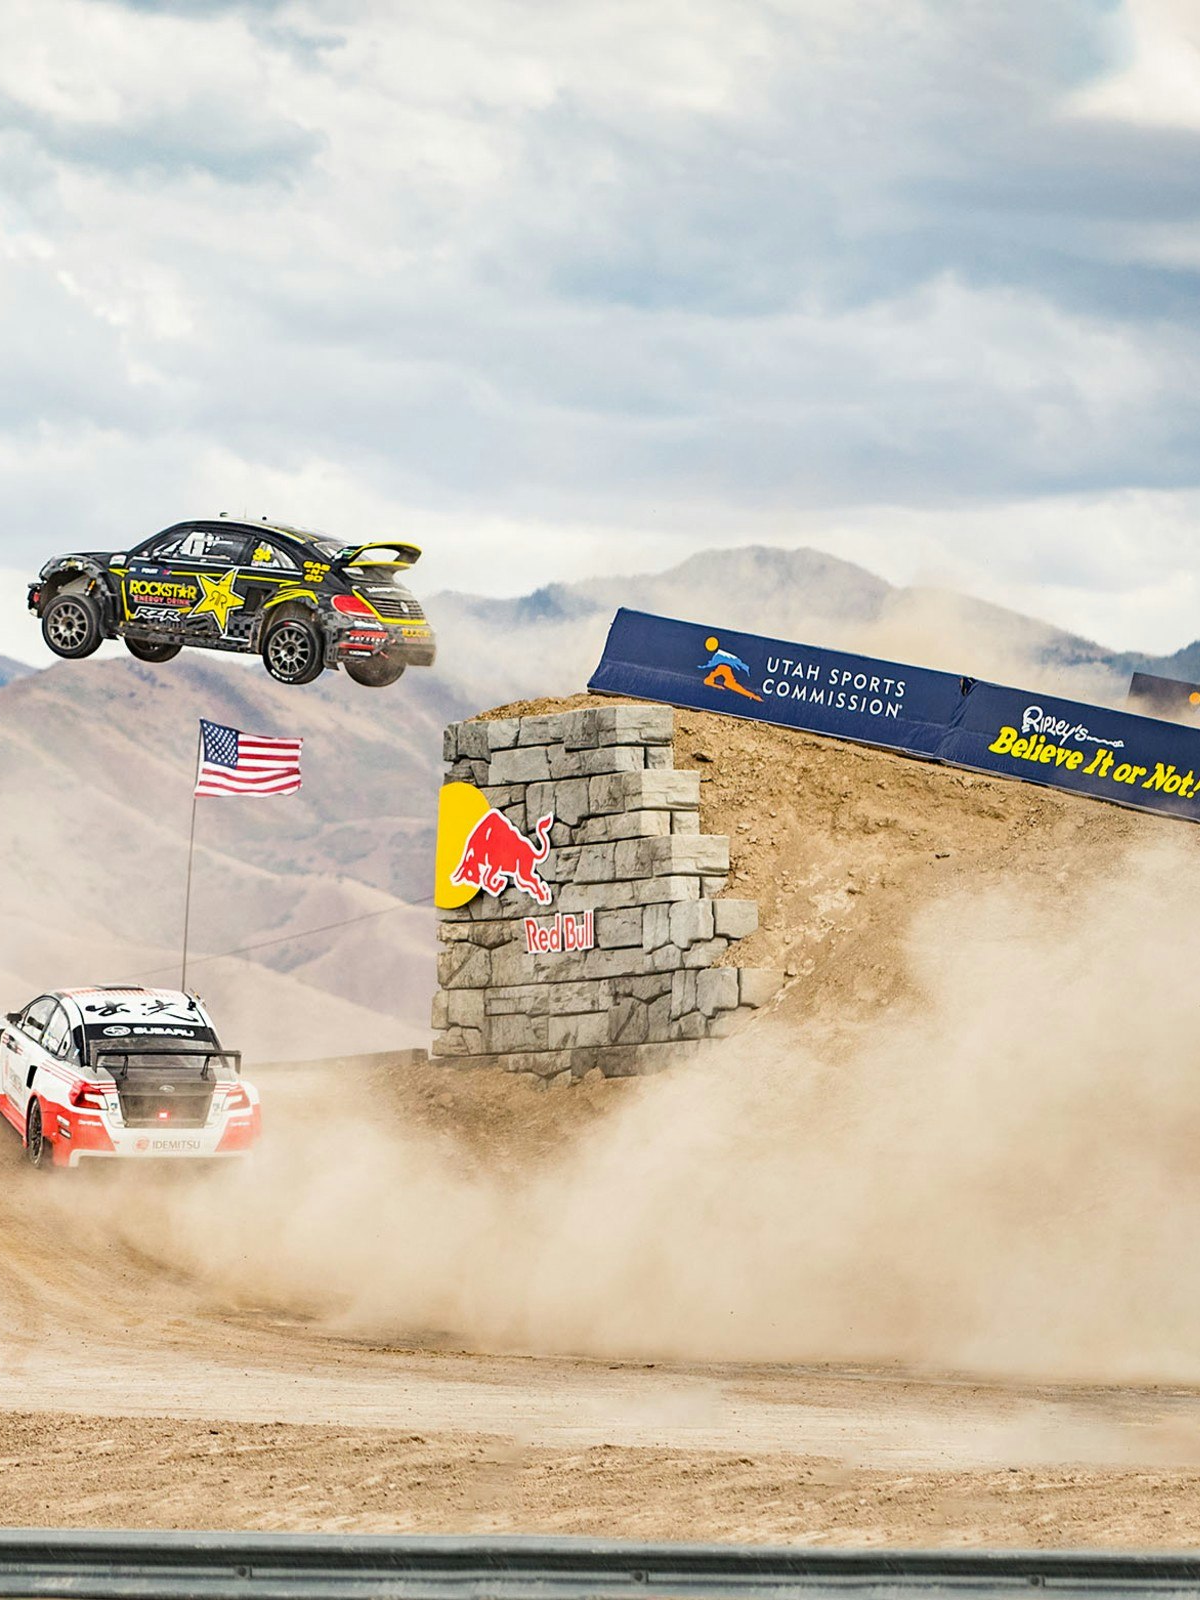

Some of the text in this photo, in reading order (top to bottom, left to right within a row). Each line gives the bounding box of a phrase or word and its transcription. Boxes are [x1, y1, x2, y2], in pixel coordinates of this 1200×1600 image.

[766, 656, 906, 698] UTAH SPORTS
[988, 725, 1200, 799] Believe It or Not!
[524, 910, 595, 954] Red Bull
[133, 1027, 196, 1037] SUBARU
[151, 1139, 201, 1150] IDEMITSU
